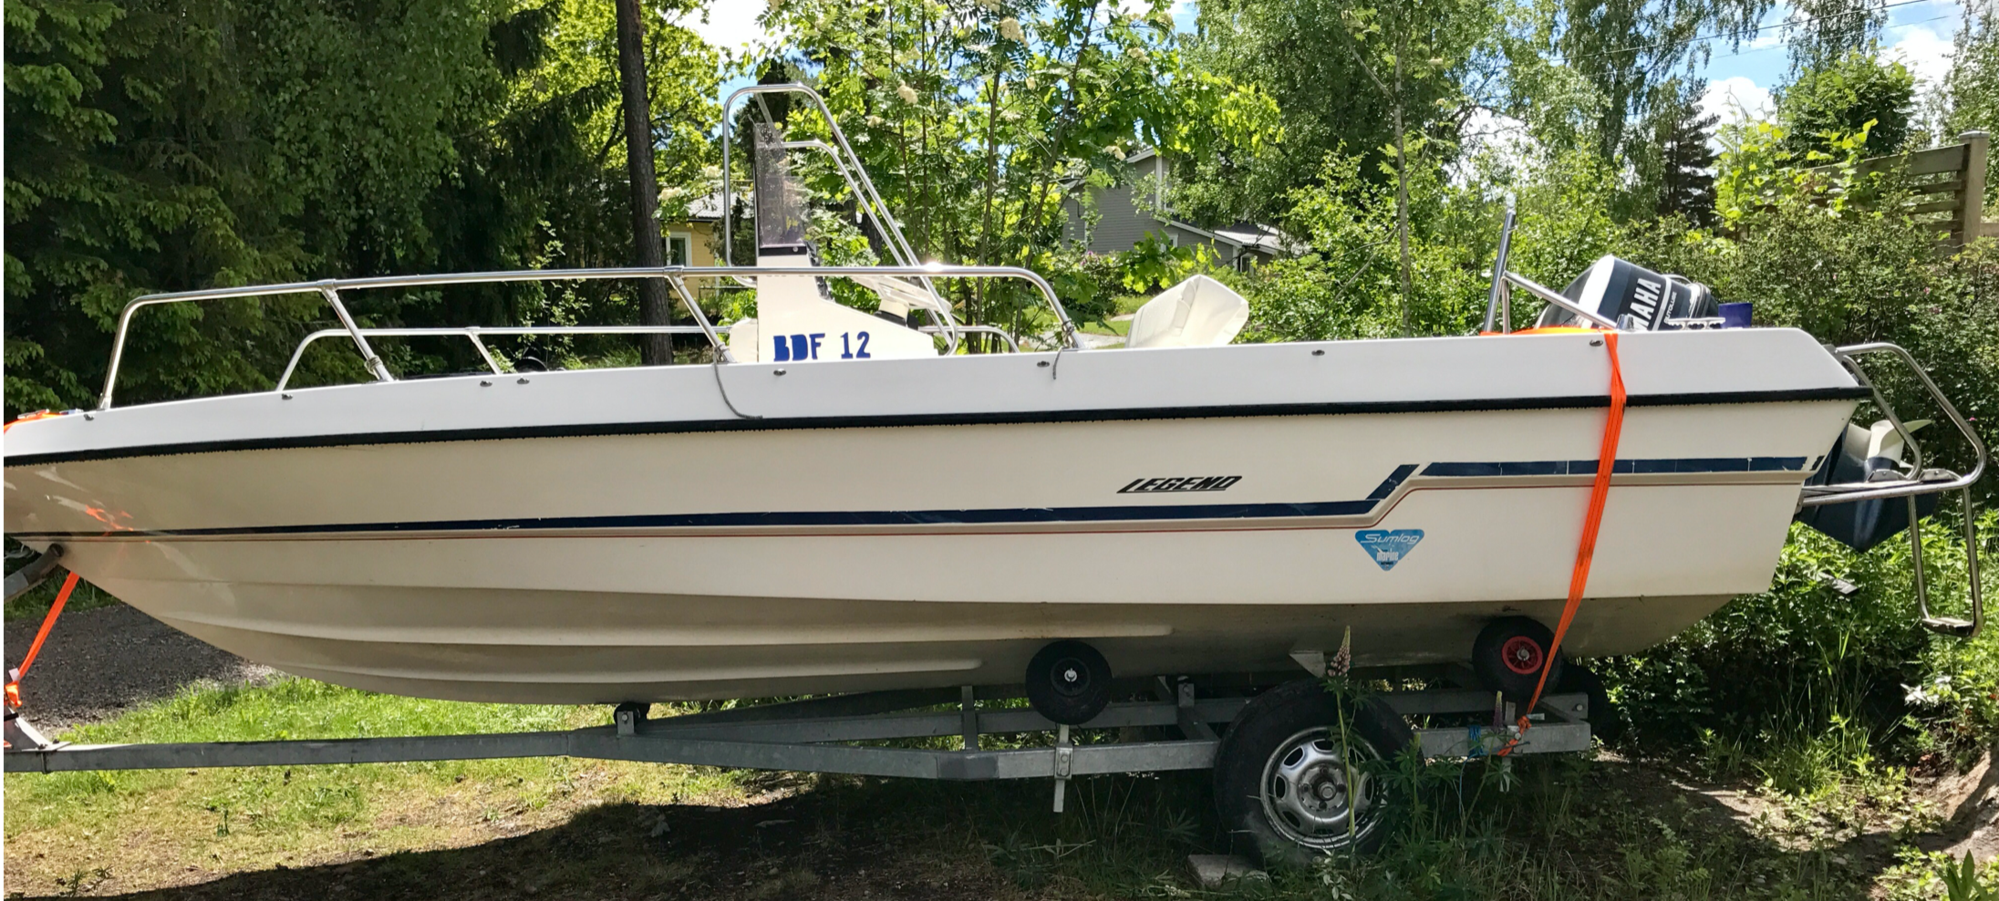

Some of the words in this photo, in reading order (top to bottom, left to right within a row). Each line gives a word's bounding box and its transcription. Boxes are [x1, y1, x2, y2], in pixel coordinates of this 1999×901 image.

[773, 333, 826, 362] BDF
[840, 331, 871, 359] 12
[1116, 475, 1243, 493] LEGEND
[1360, 533, 1420, 545] Sumlog
